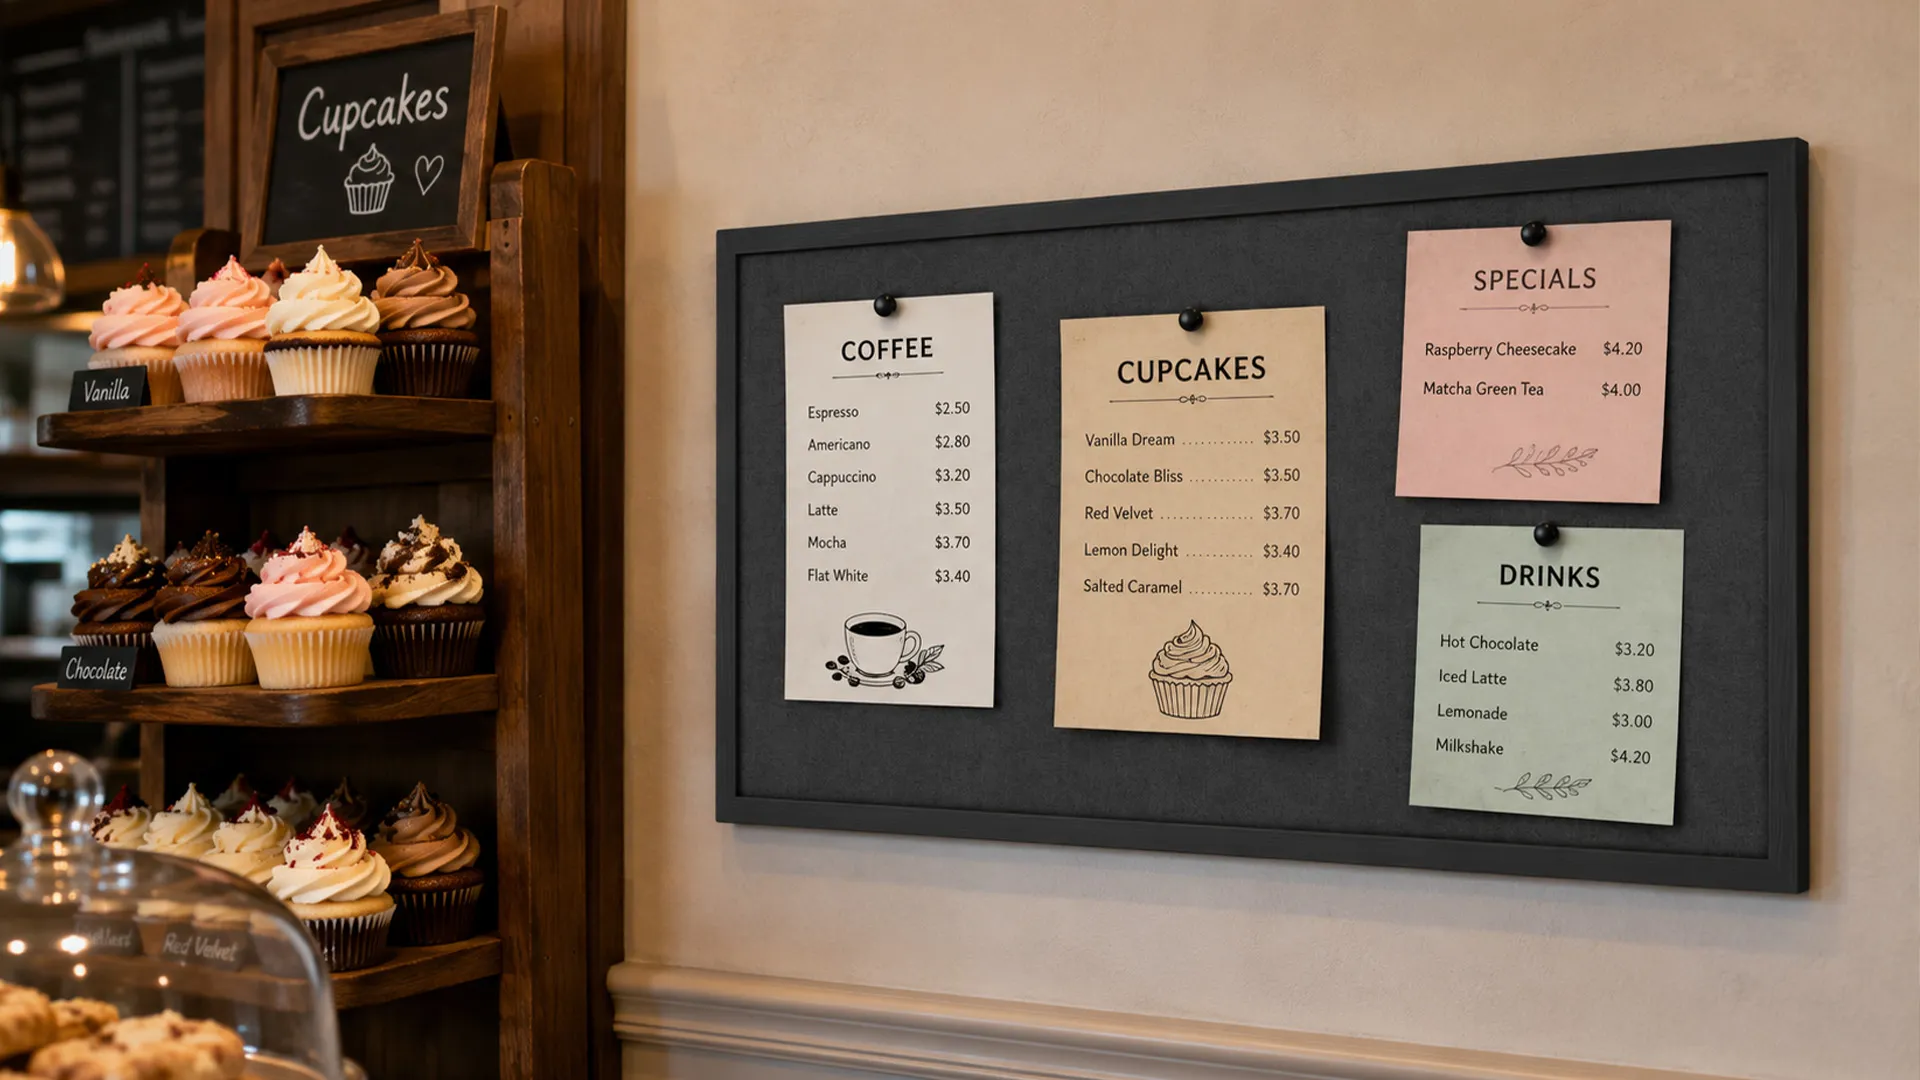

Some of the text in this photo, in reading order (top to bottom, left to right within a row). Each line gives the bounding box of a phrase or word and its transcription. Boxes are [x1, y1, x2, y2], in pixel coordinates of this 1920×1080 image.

[298, 73, 449, 152] Cupcakes
[1473, 268, 1596, 291] SPECIALS
[841, 337, 932, 361] COFFEE
[1425, 341, 1642, 360] Raspberry Cheesecake $4.20
[1117, 356, 1265, 384] CUPCAKES
[85, 378, 129, 402] Vanilla
[1423, 381, 1641, 397] Matcha Green Tea $4.00
[808, 401, 970, 421] Espresso $2.50
[807, 435, 970, 451] Americano $2.80
[1085, 430, 1300, 446] Vanilla Dream $3.50
[807, 468, 970, 487] Cappuccino $3.20
[1084, 468, 1300, 483] Chocolate Bliss $3.50
[807, 502, 970, 516] Latte $3.50
[1084, 506, 1300, 520] Red Velvet $3.70
[807, 535, 970, 549] Mocha $3.70
[1084, 543, 1300, 560] Lemon Delight $3.40
[807, 568, 970, 583] Flat White $3.40
[1500, 564, 1599, 588] DRINKS
[1083, 579, 1299, 596] Salted Caramel $3.70
[1440, 634, 1654, 656] Hot Chocolate $3.20
[66, 657, 127, 680] Chocolate
[1439, 669, 1653, 693] Iced Latte $3.80
[1437, 704, 1652, 728] Lemonade $3.00
[1435, 738, 1650, 764] Milkshake $4.20
[163, 932, 239, 961] Red Velvet
